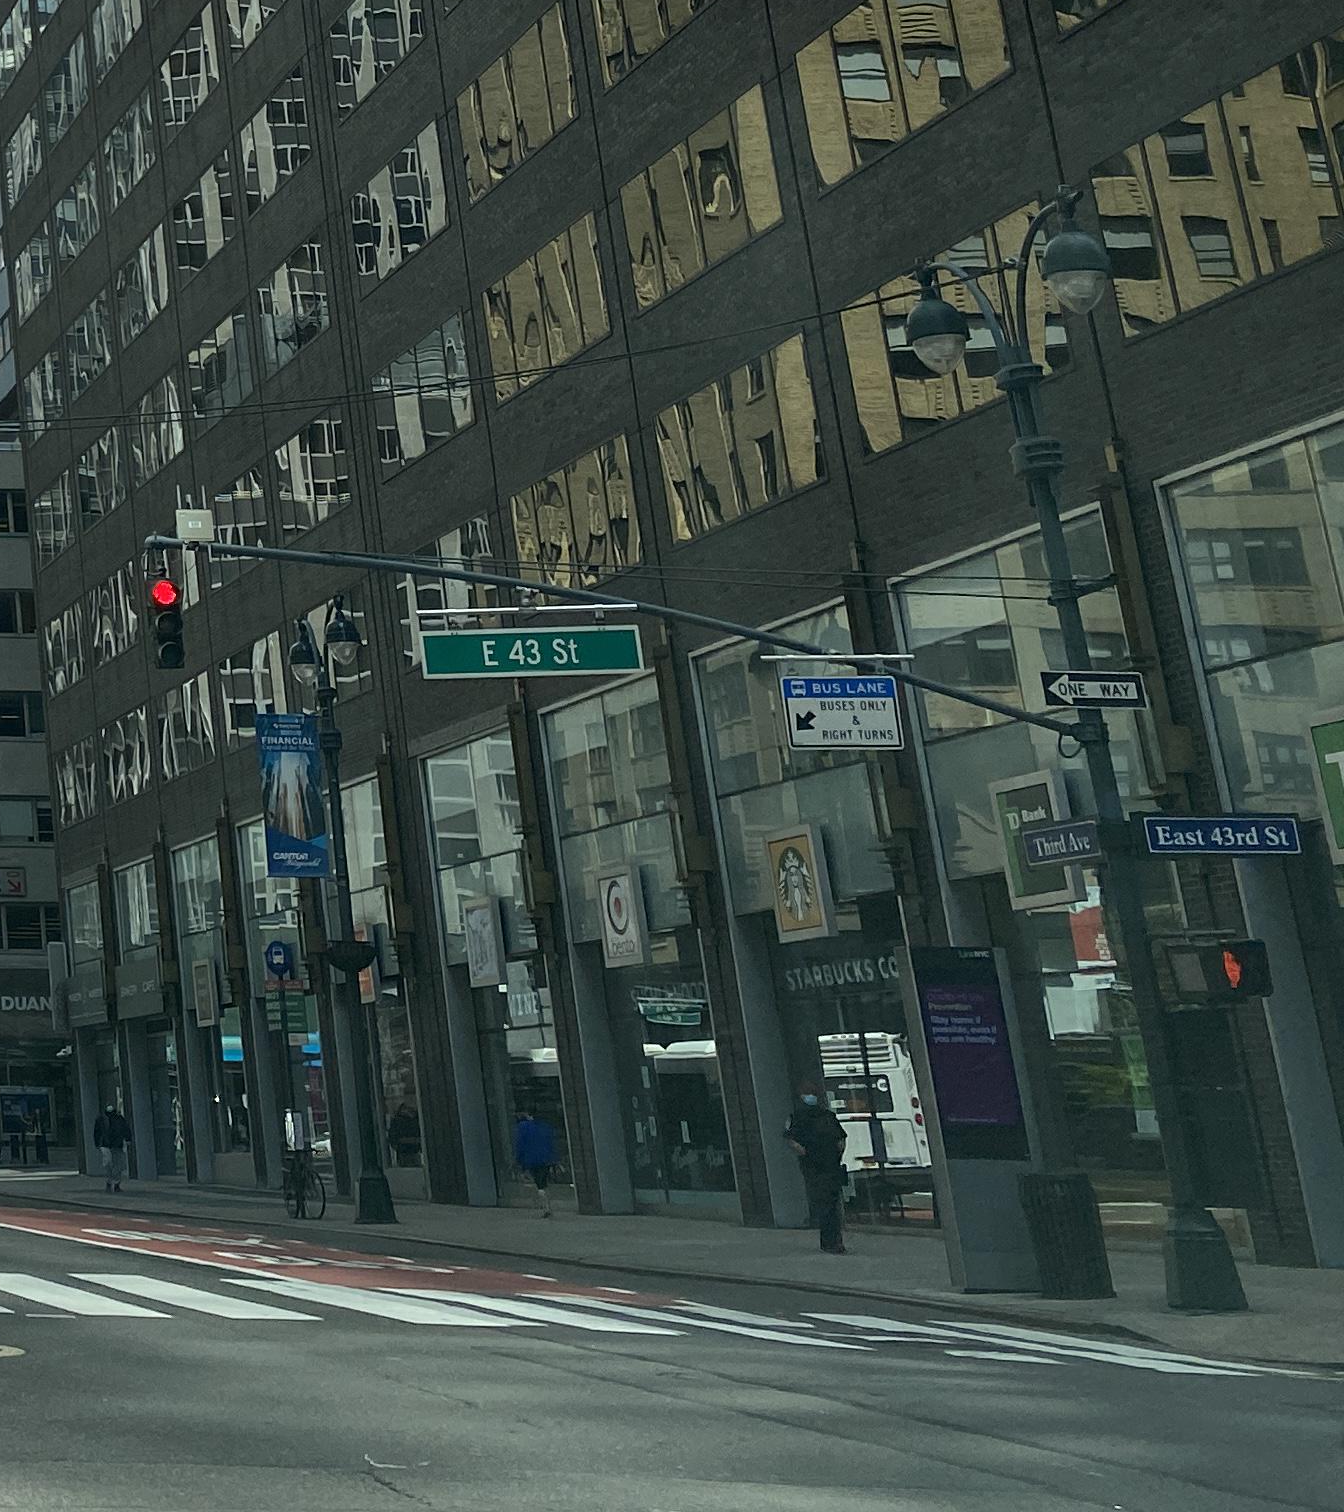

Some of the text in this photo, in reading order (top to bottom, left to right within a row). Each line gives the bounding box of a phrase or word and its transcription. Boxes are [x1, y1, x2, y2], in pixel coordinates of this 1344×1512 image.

[482, 638, 579, 666] E 43 St
[812, 682, 887, 694] BUS LANE
[1057, 682, 1130, 698] ONE WAY
[820, 700, 887, 711] BUSES ONLY
[852, 715, 860, 726] &
[261, 736, 314, 746] FINANCIAL
[822, 729, 894, 741] RIGHT TURNS
[1020, 806, 1046, 822] Bank
[1155, 825, 1291, 847] East 43rd St
[1032, 832, 1091, 857] Third Ave
[785, 958, 874, 991] STARBUCKS
[1, 996, 53, 1011] DUAN
